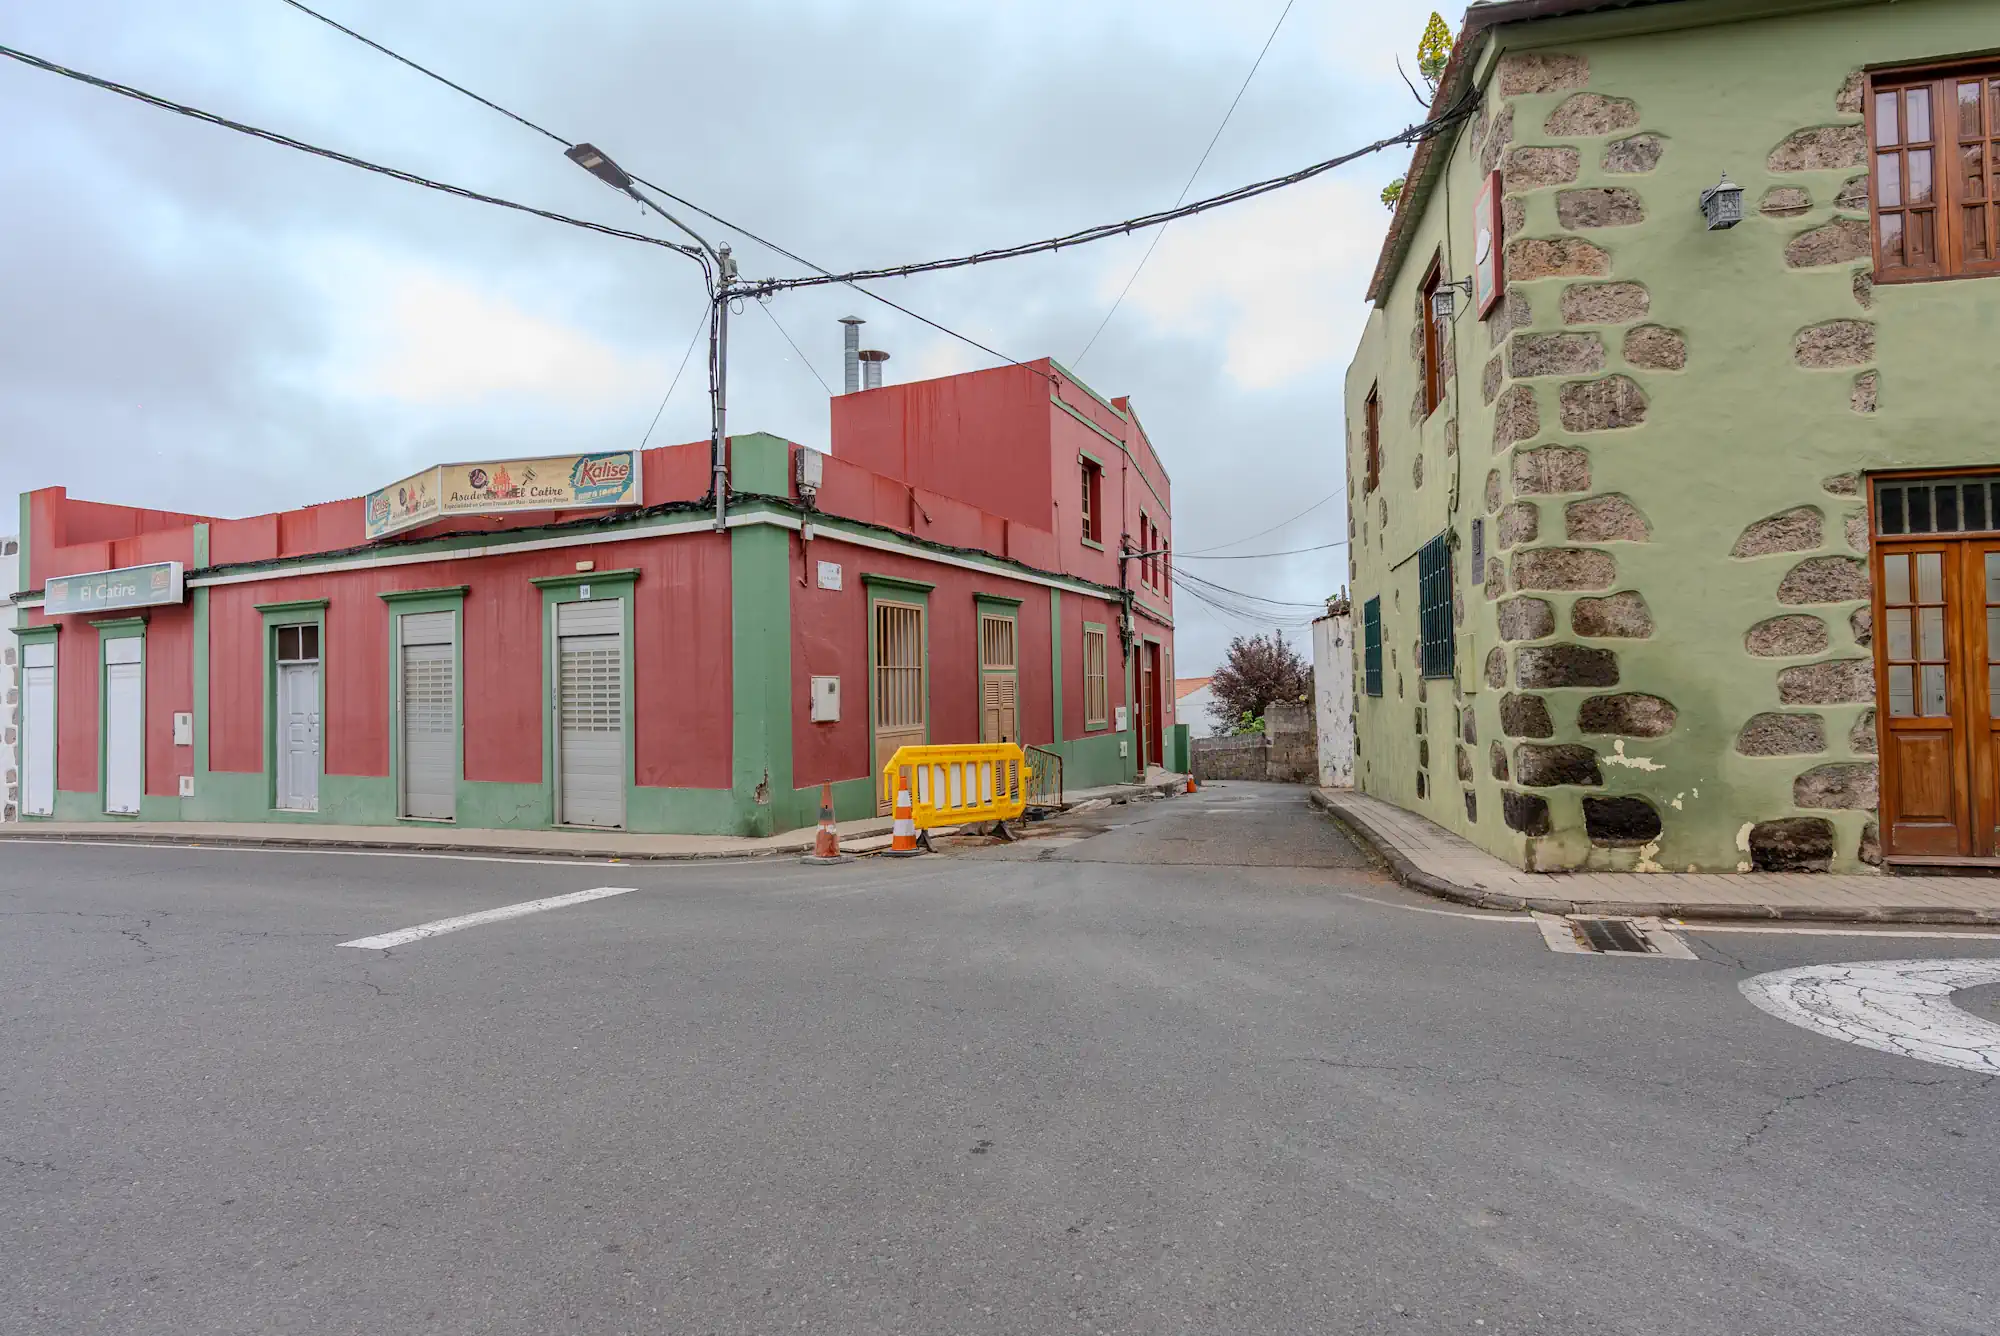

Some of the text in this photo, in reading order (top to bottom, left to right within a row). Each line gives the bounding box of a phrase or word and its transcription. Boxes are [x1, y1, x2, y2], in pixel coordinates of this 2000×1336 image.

[580, 459, 629, 487] Kalise
[515, 487, 525, 498] El
[530, 486, 563, 497] Catire
[81, 586, 91, 601] El
[96, 584, 136, 599] Catire
